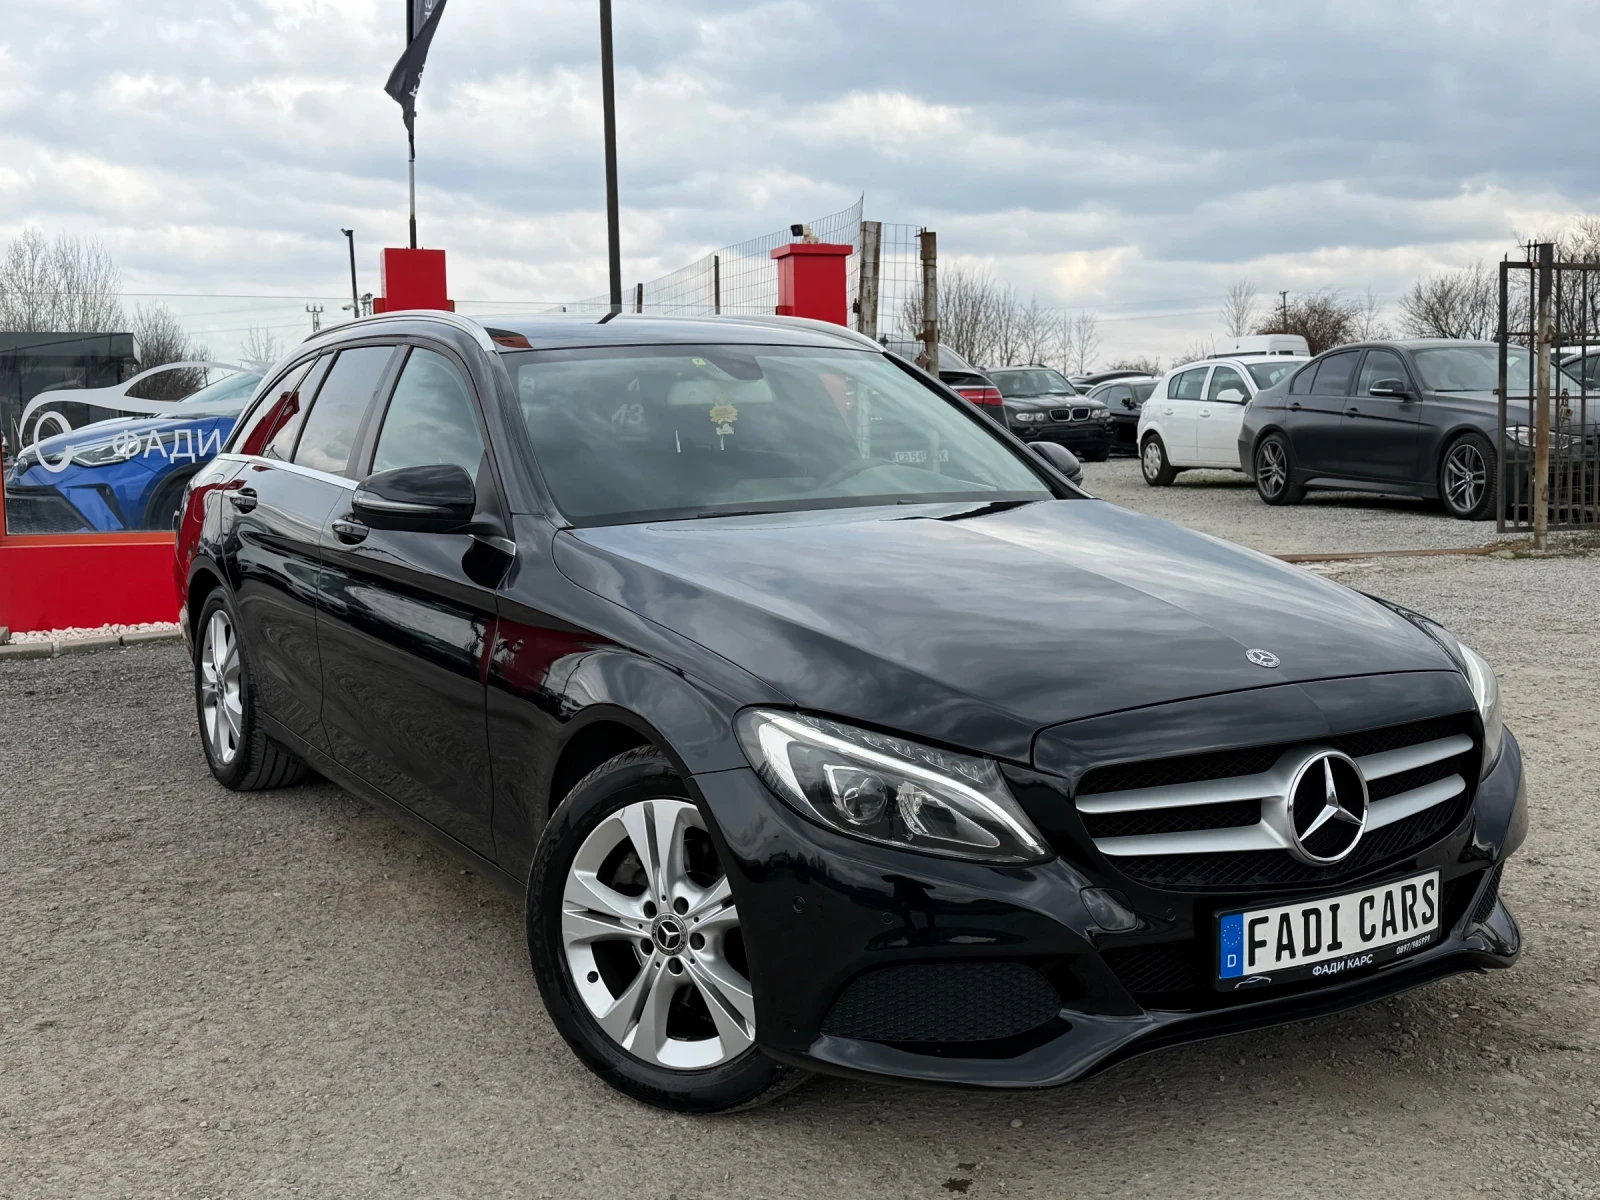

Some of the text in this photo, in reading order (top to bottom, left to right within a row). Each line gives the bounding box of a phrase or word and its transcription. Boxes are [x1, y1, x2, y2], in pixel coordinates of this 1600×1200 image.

[112, 428, 222, 464] ФАДИ
[1248, 878, 1435, 967] FADI CARS
[1227, 954, 1237, 968] D
[1312, 954, 1374, 976] ФАДИ КАРС
